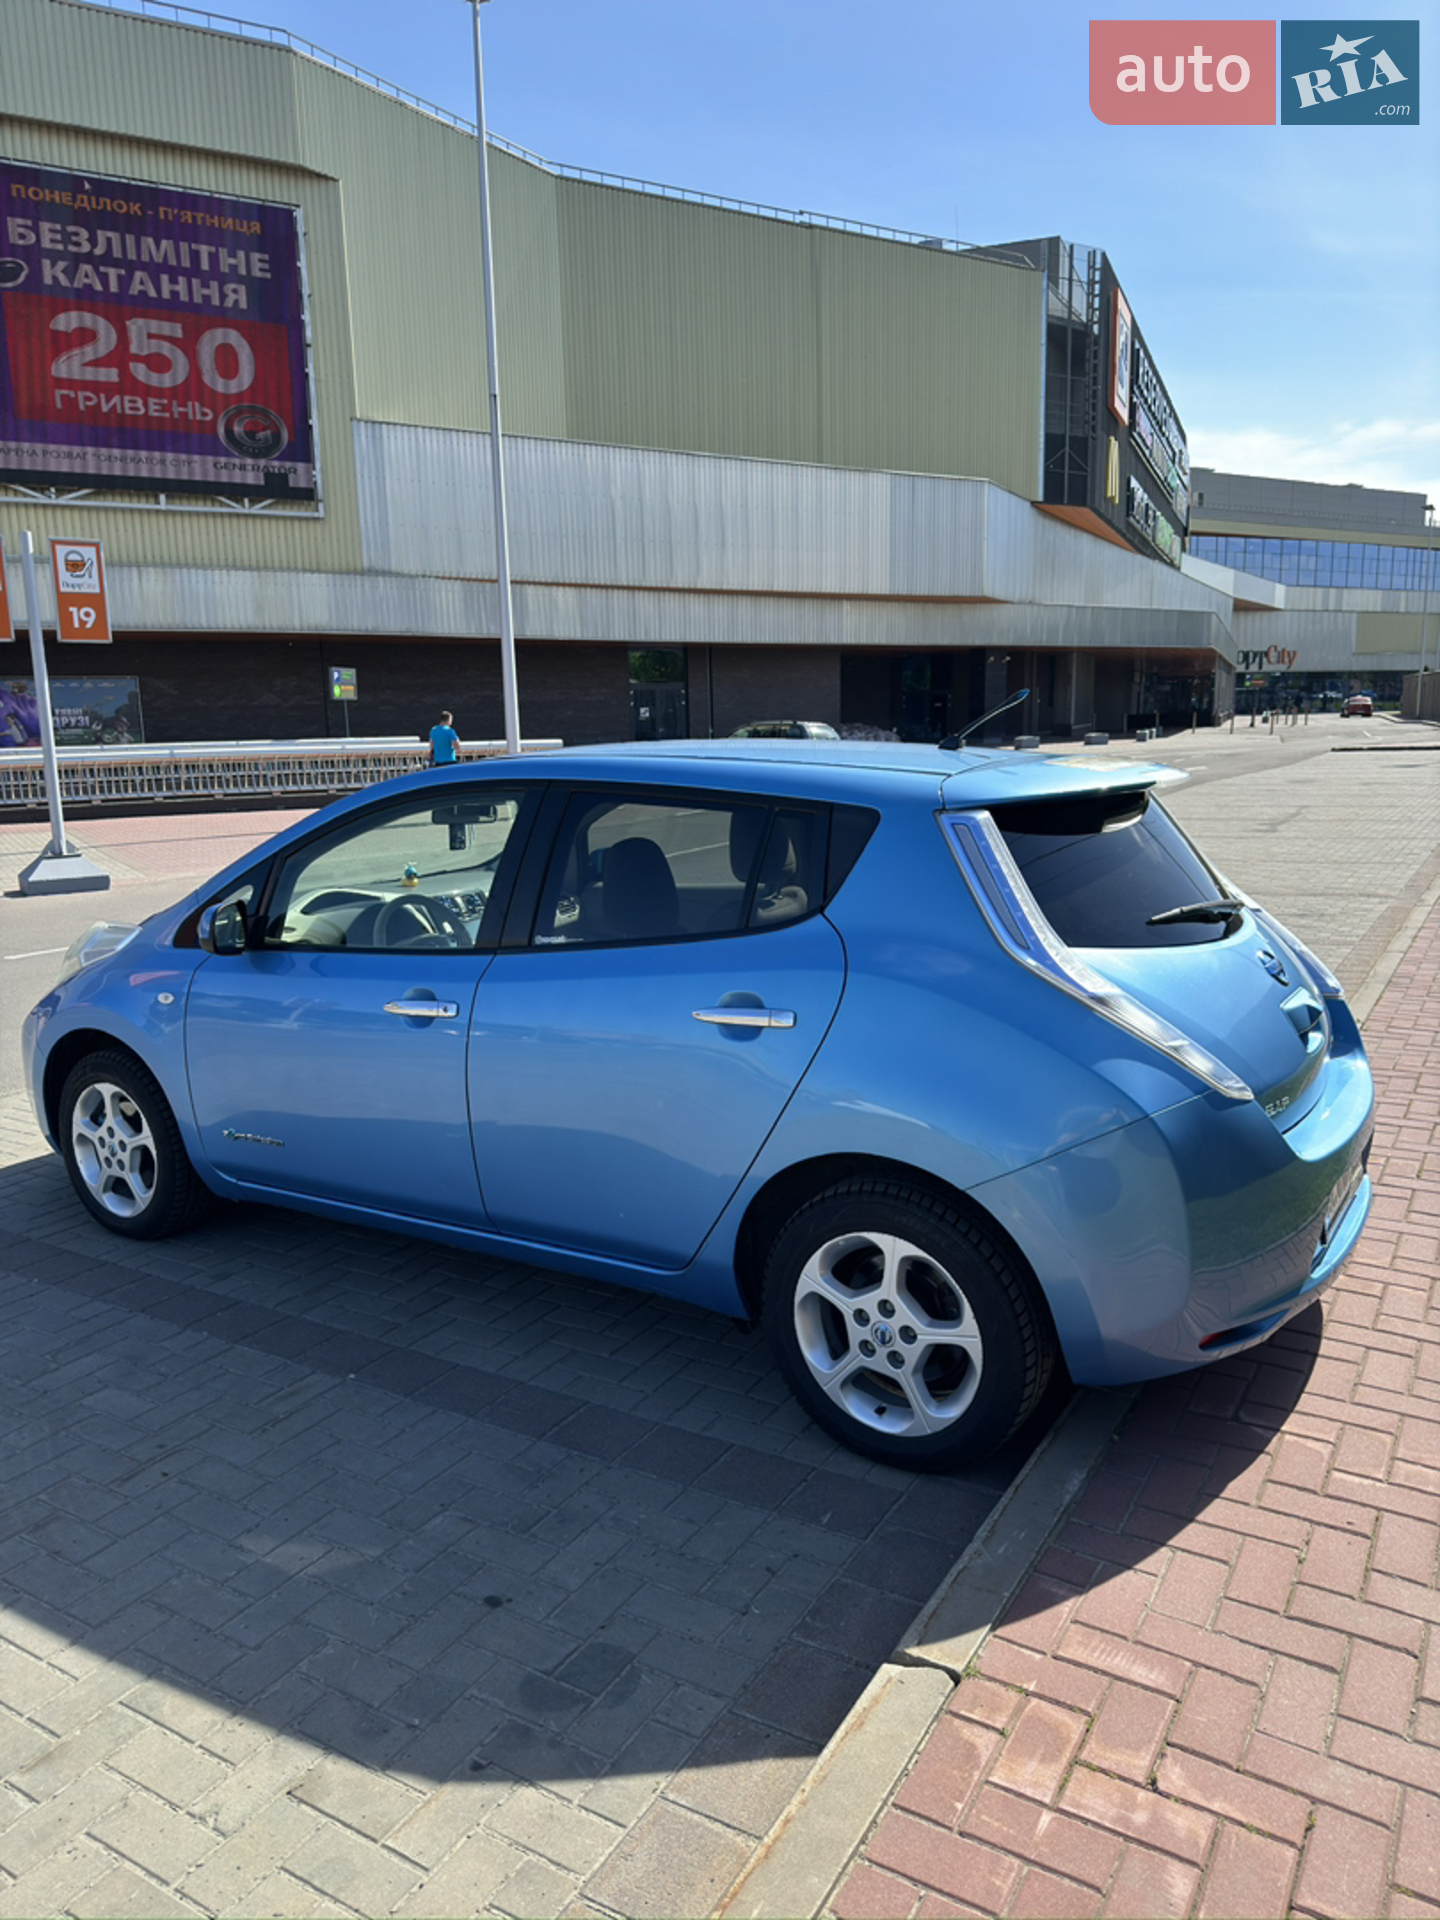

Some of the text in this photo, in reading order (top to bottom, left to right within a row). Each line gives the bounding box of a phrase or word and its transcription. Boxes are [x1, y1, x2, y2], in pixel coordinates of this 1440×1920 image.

[10, 183, 143, 217] ПОНЕДІЛОК
[6, 216, 272, 280] БЕЗЛІМІТНЕ
[41, 258, 248, 310] КАТАННЯ
[49, 310, 256, 395] 250
[54, 388, 214, 422] ГРИВЕНЬ
[42, 448, 88, 461] РОЗВАГ
[213, 461, 298, 476] GENERATOR
[68, 606, 97, 629] 19
